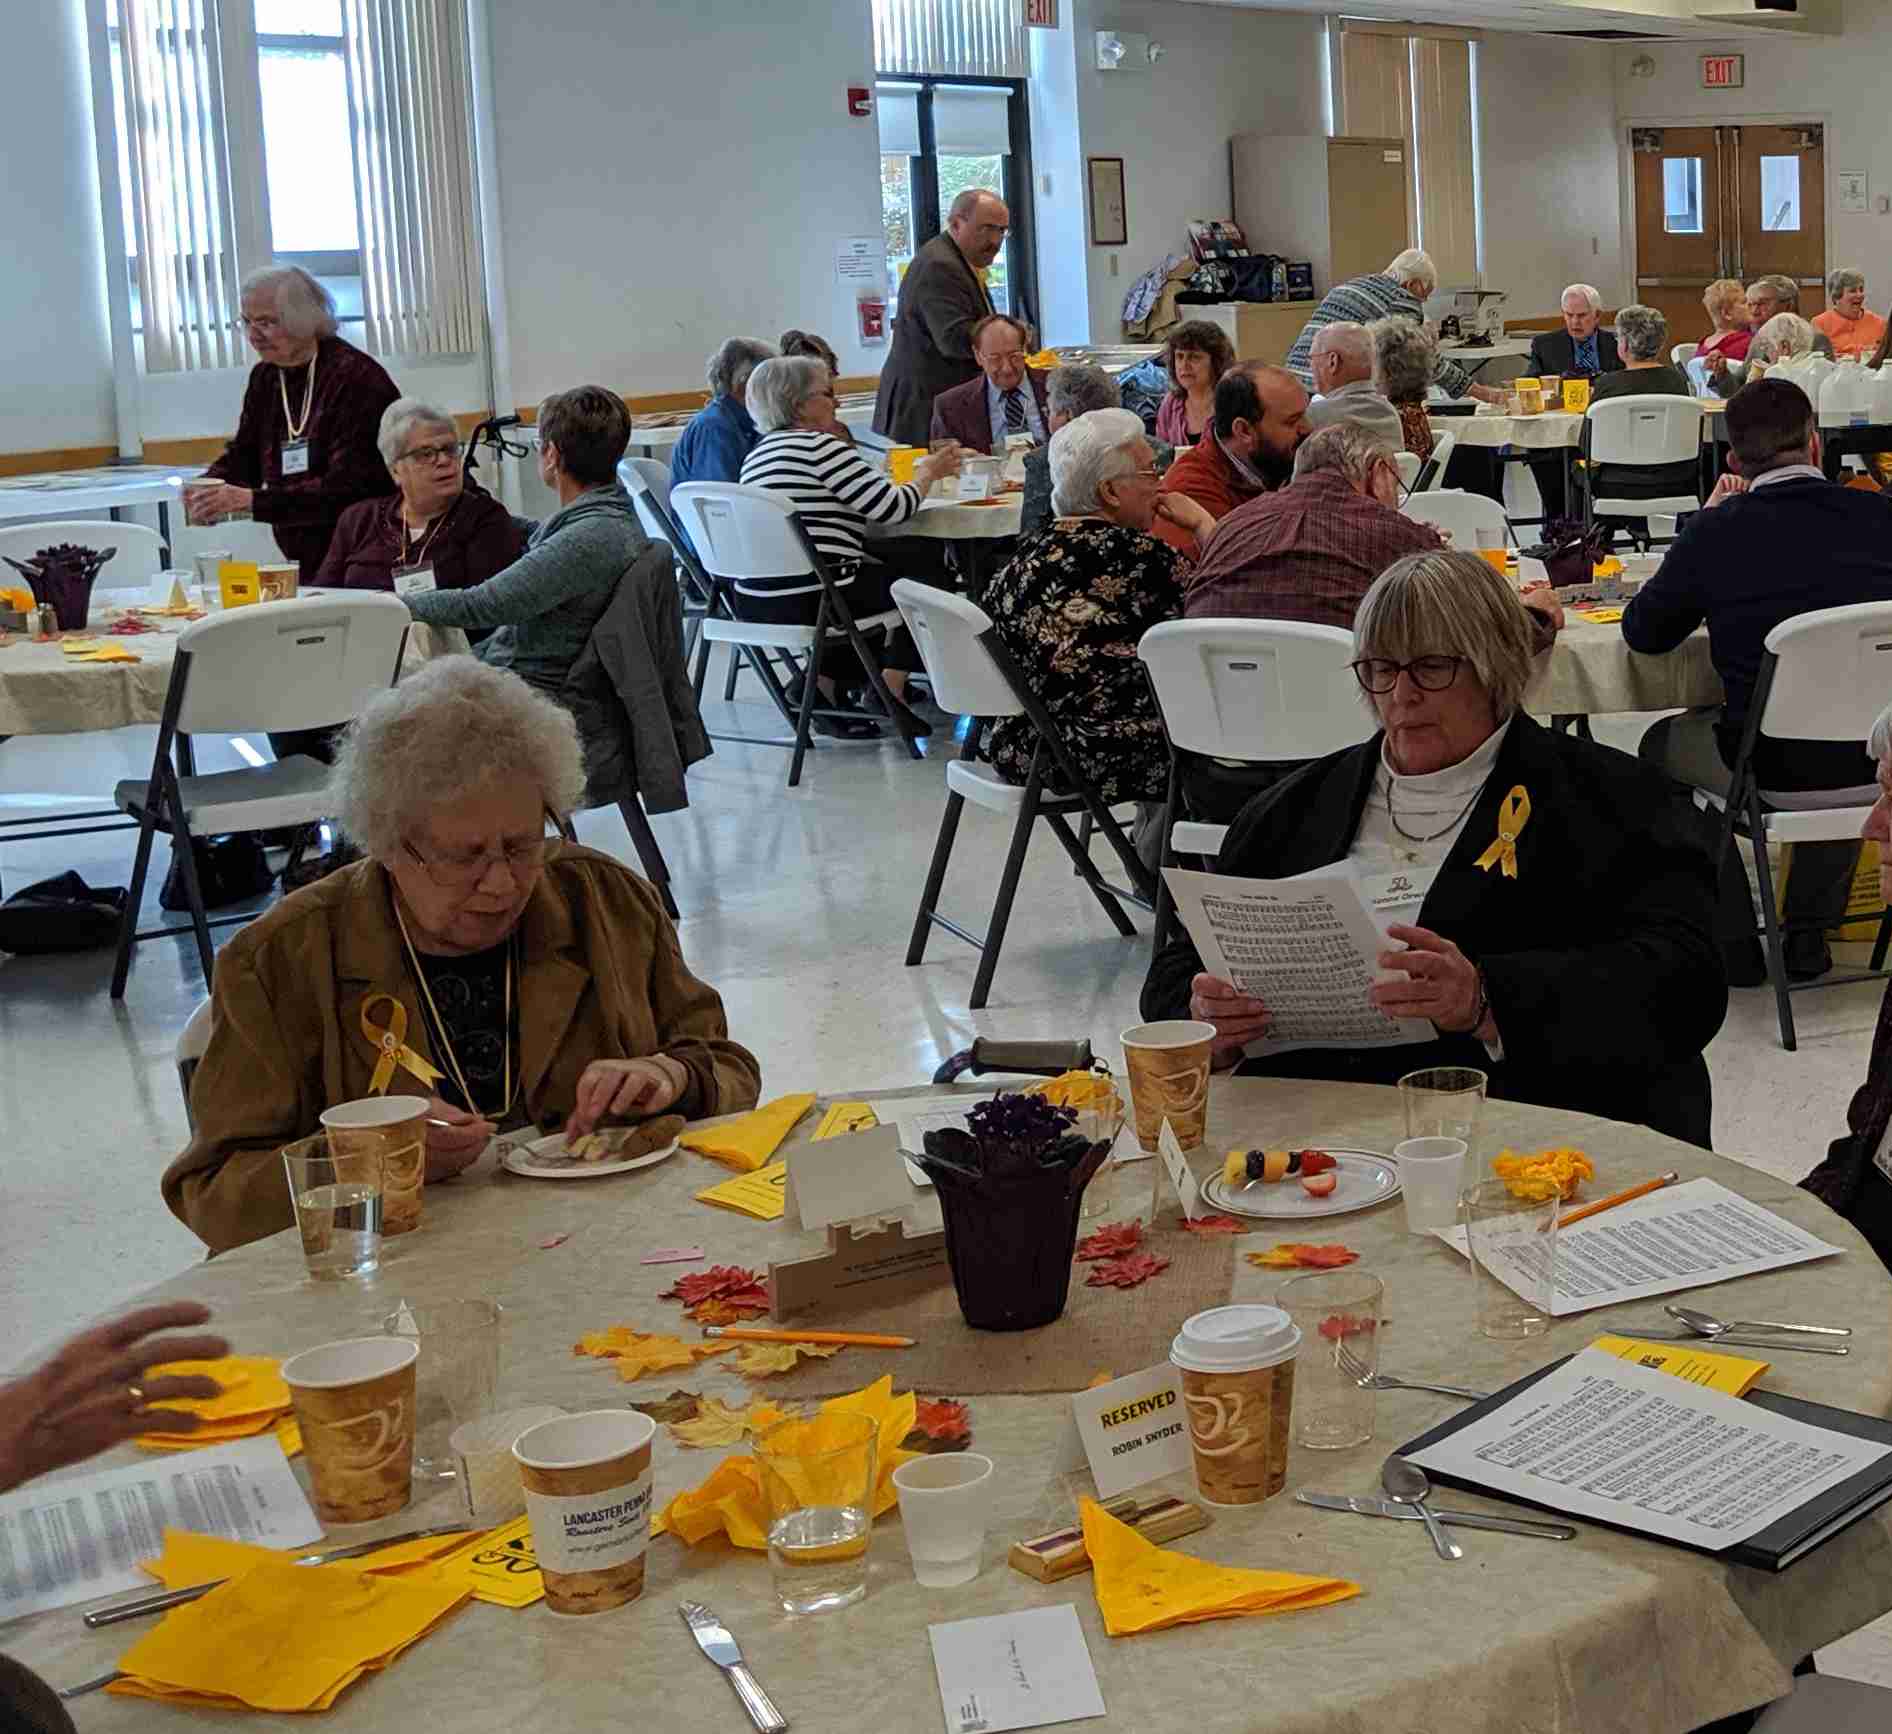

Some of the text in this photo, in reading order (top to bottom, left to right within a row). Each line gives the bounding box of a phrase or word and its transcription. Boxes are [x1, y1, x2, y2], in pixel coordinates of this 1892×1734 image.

[1704, 59, 1736, 84] EXIT
[1100, 1390, 1176, 1428] RESERVED
[1111, 1422, 1184, 1457] ROBIN SNYDER
[563, 1503, 622, 1526] LANCASTER
